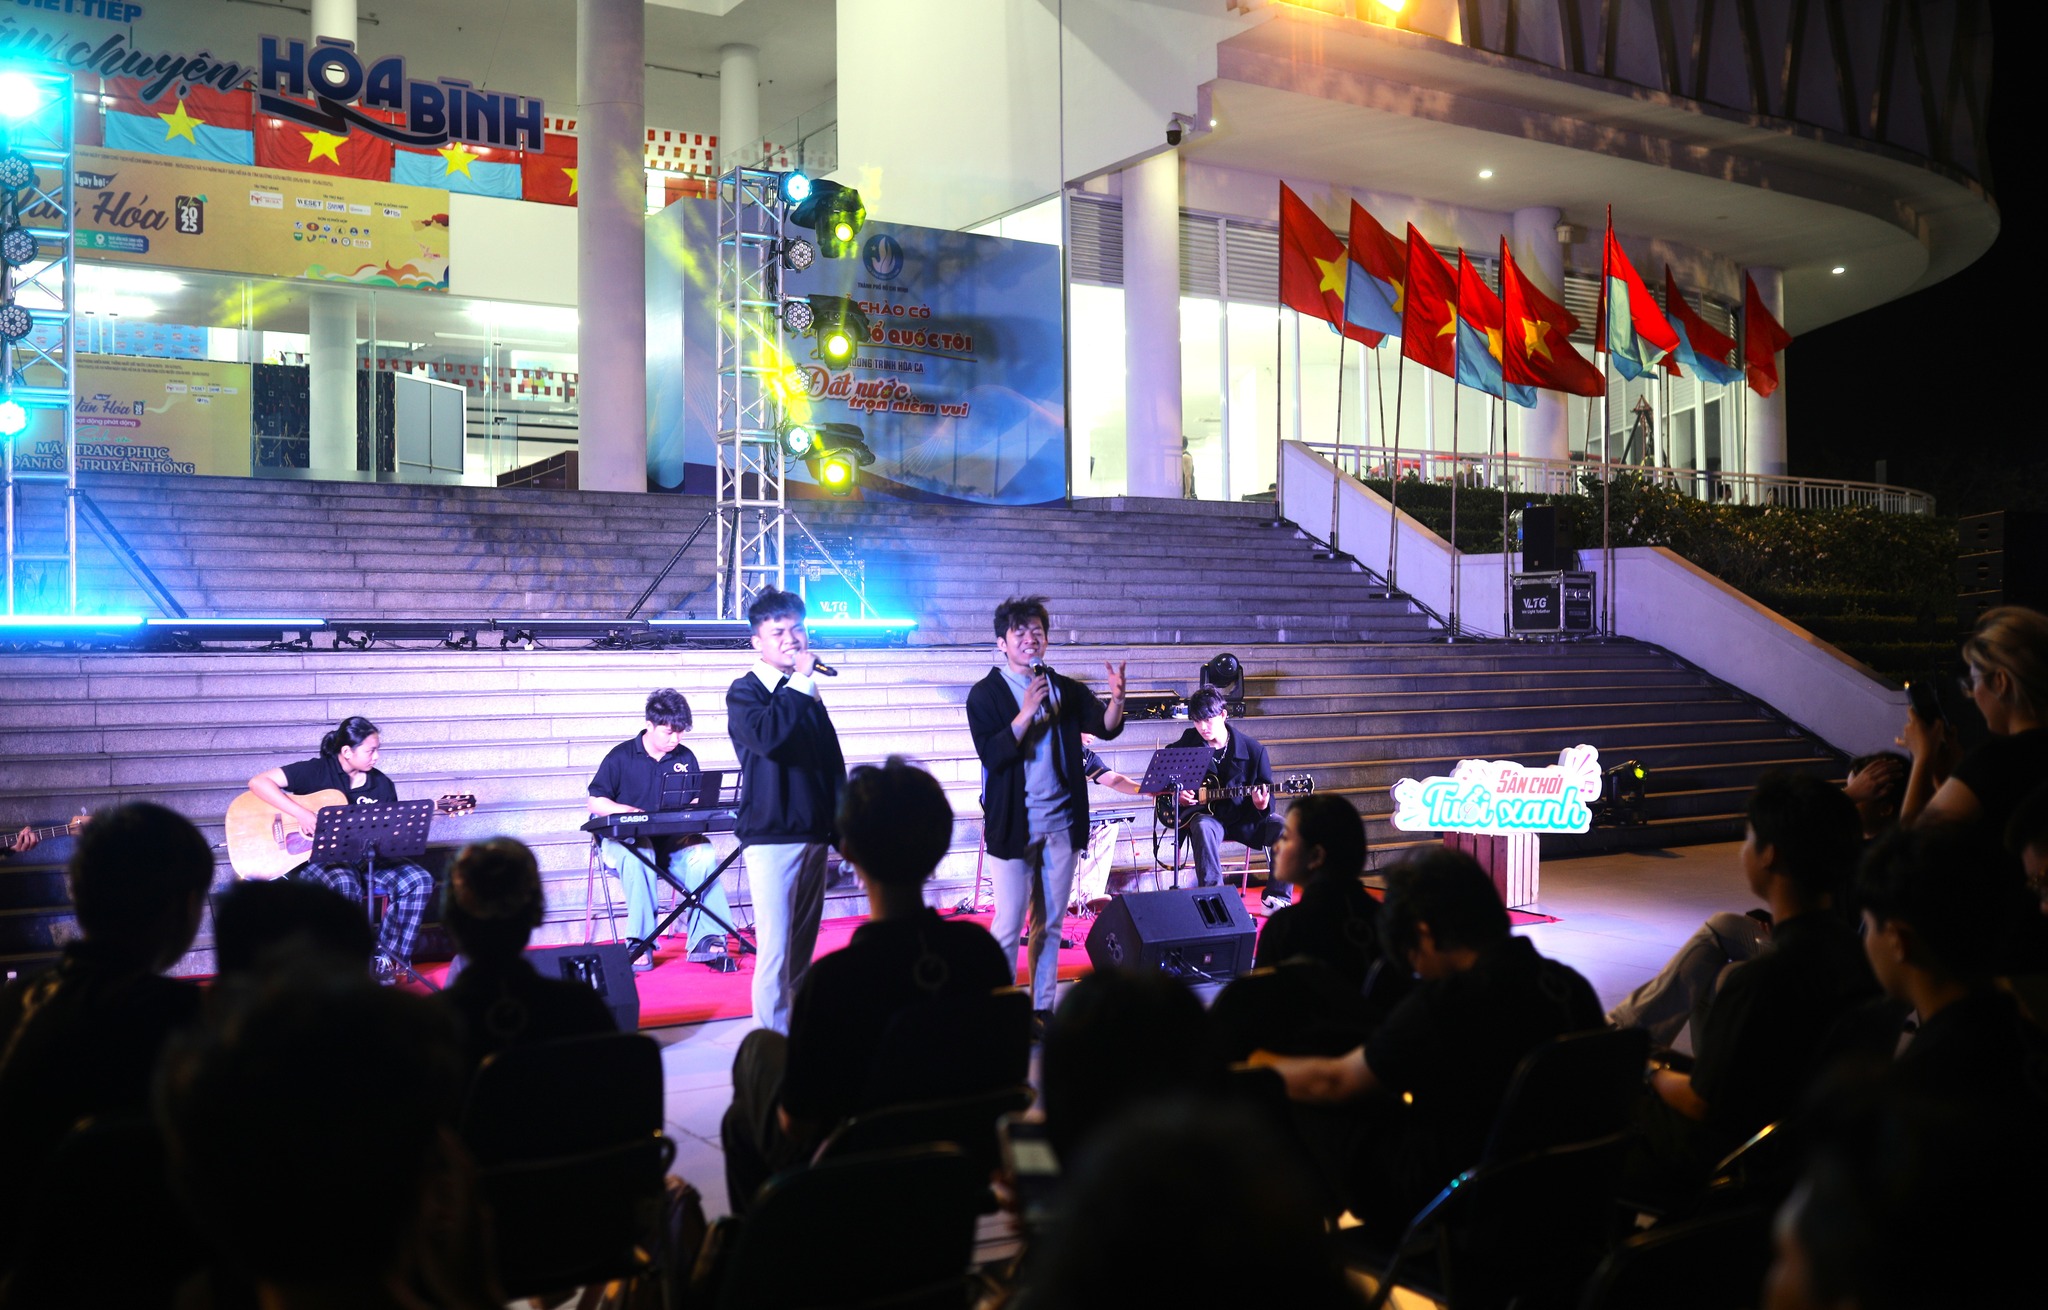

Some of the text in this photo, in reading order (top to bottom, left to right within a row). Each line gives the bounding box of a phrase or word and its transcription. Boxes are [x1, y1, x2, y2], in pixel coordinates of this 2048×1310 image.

[92, 191, 170, 231] Hóa
[908, 303, 931, 319] CỜ
[888, 327, 939, 347] QUỐC
[941, 331, 972, 351] TÔI
[939, 403, 969, 416] vui
[1496, 769, 1564, 795] SÂN CHƠI
[619, 814, 649, 823] CASIO
[1496, 785, 1587, 829] xanh
